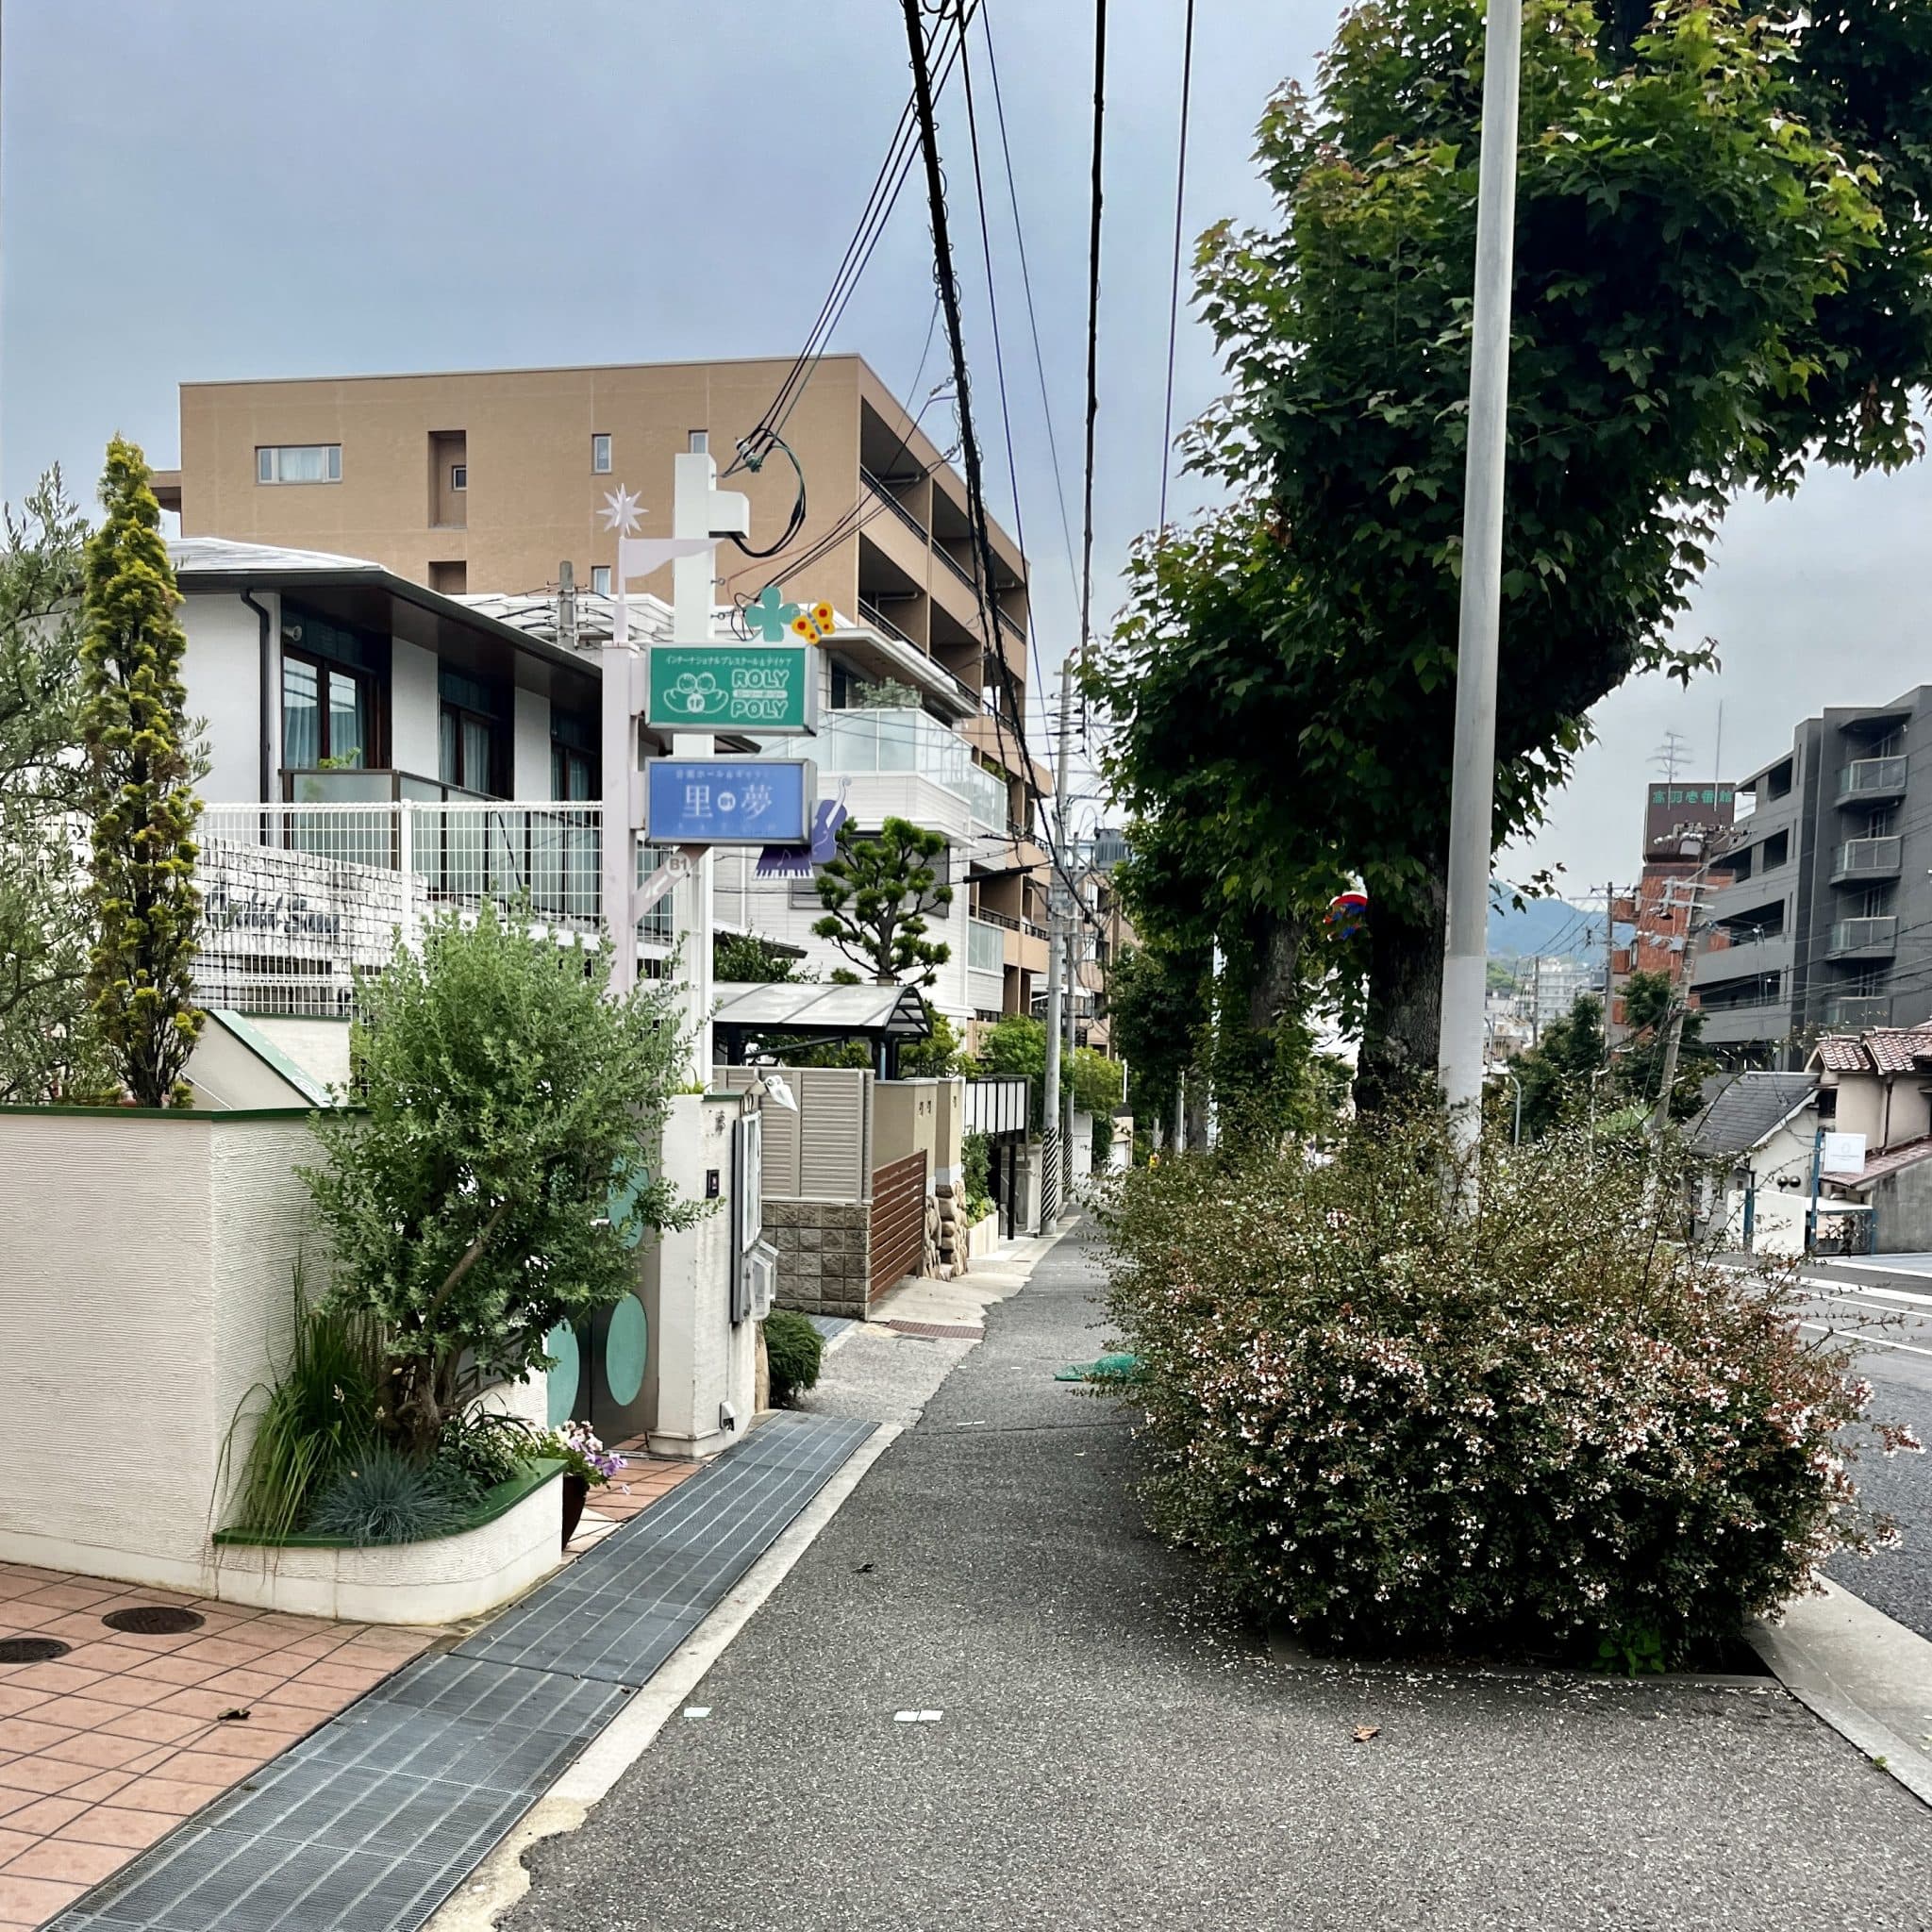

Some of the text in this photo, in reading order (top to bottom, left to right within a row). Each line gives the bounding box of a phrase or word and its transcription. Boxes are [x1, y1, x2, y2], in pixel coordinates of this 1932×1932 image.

[732, 669, 790, 688] ROLY
[731, 700, 789, 719] POLY
[682, 785, 713, 818] 里
[671, 858, 687, 871] B1
